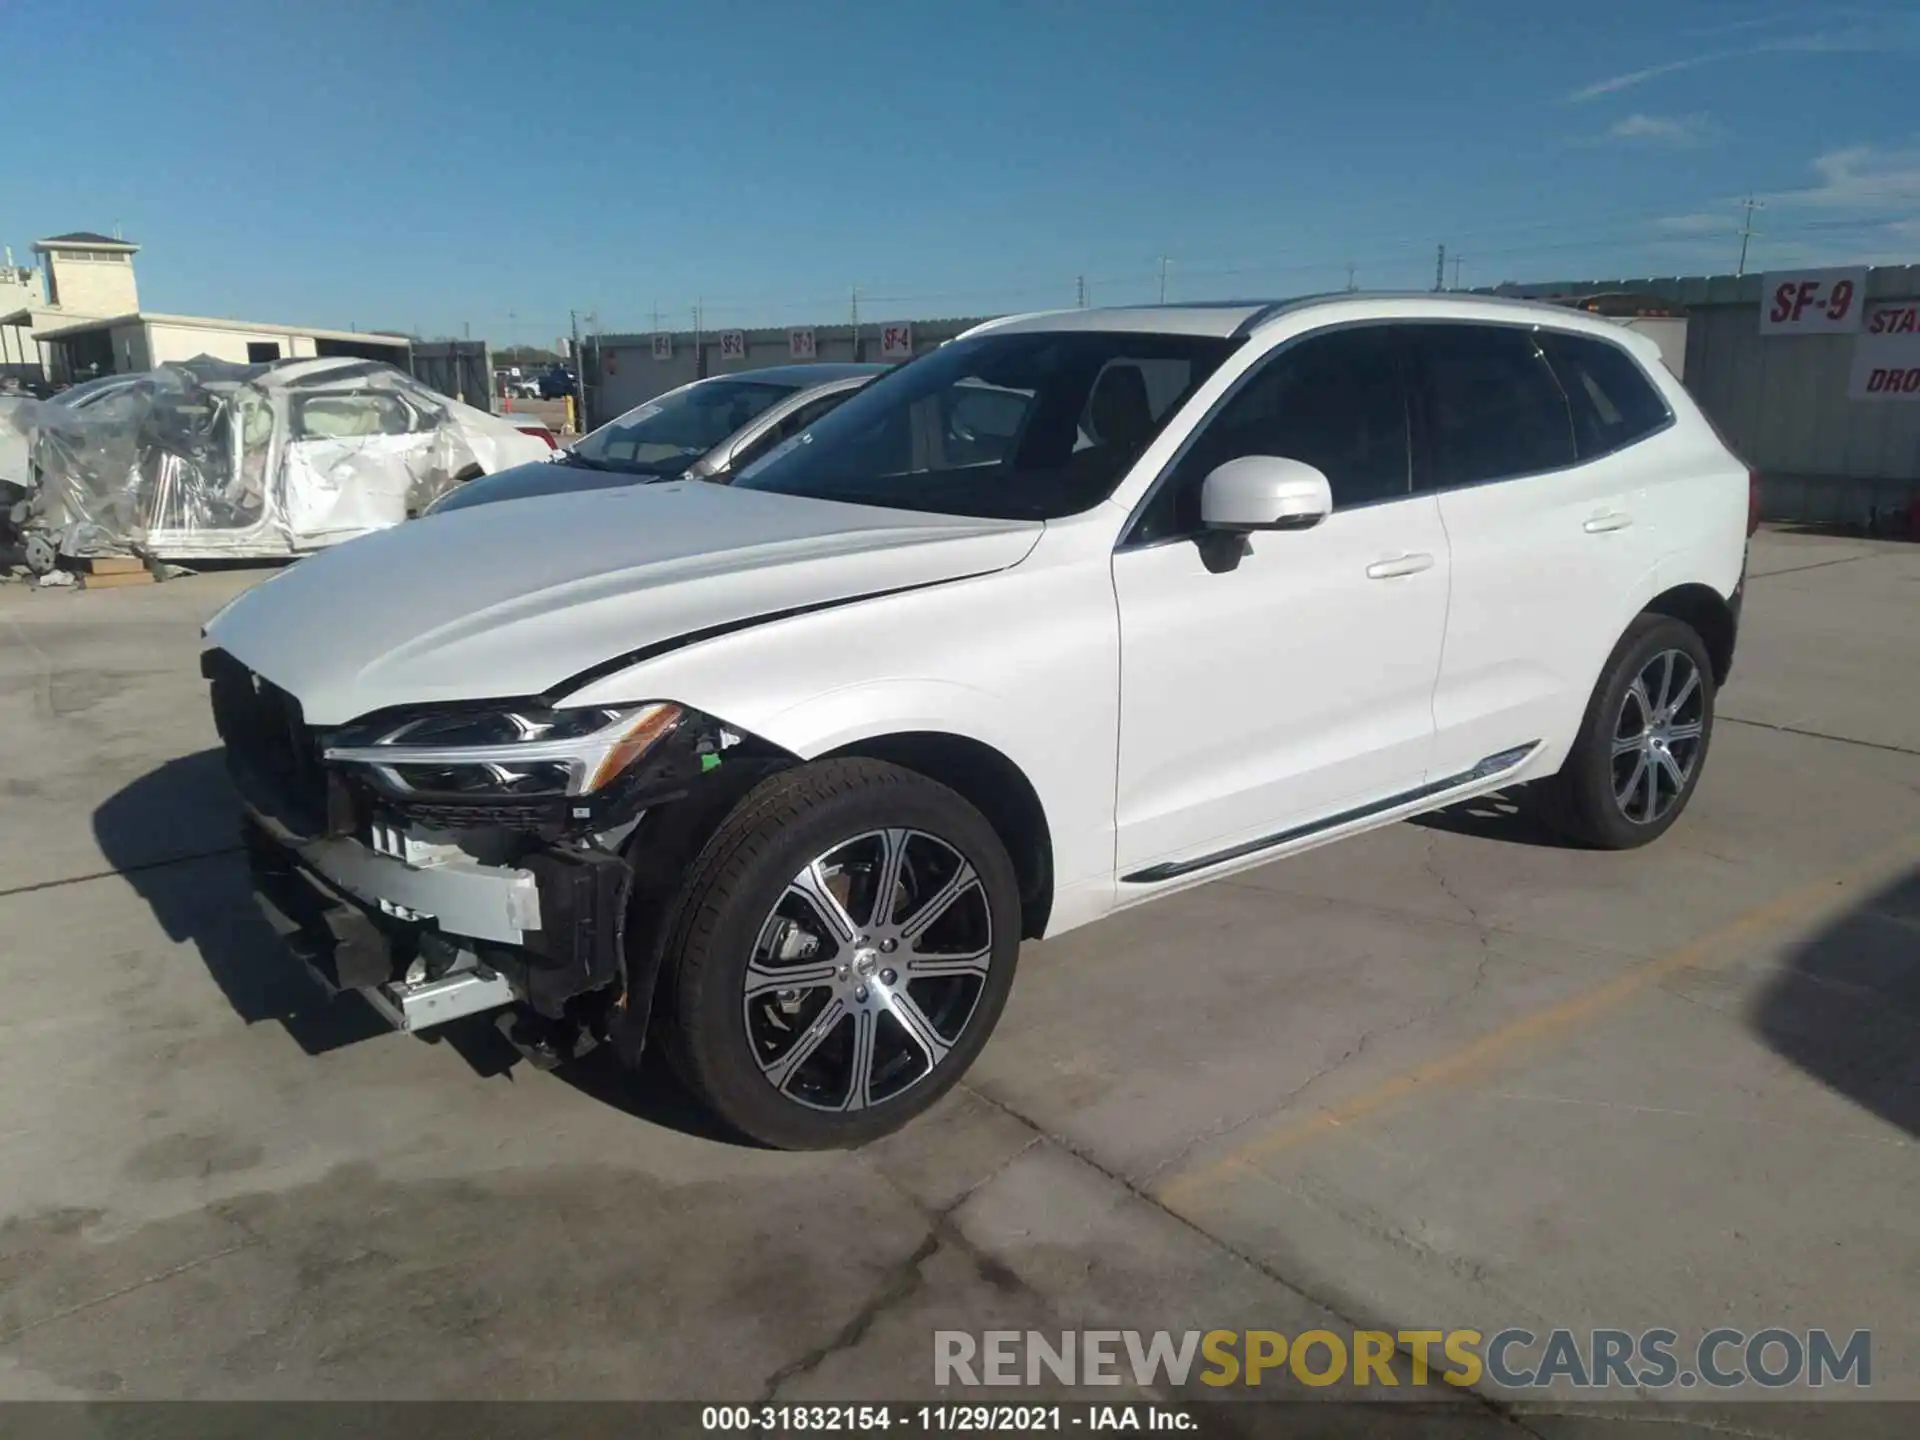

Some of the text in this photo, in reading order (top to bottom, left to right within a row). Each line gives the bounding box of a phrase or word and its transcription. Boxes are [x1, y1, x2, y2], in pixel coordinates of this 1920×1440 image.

[1770, 280, 1854, 323] SF-9
[1869, 308, 1920, 335] STA
[722, 333, 742, 354] SF-2
[884, 328, 909, 351] SF-4
[1866, 368, 1920, 393] DRO
